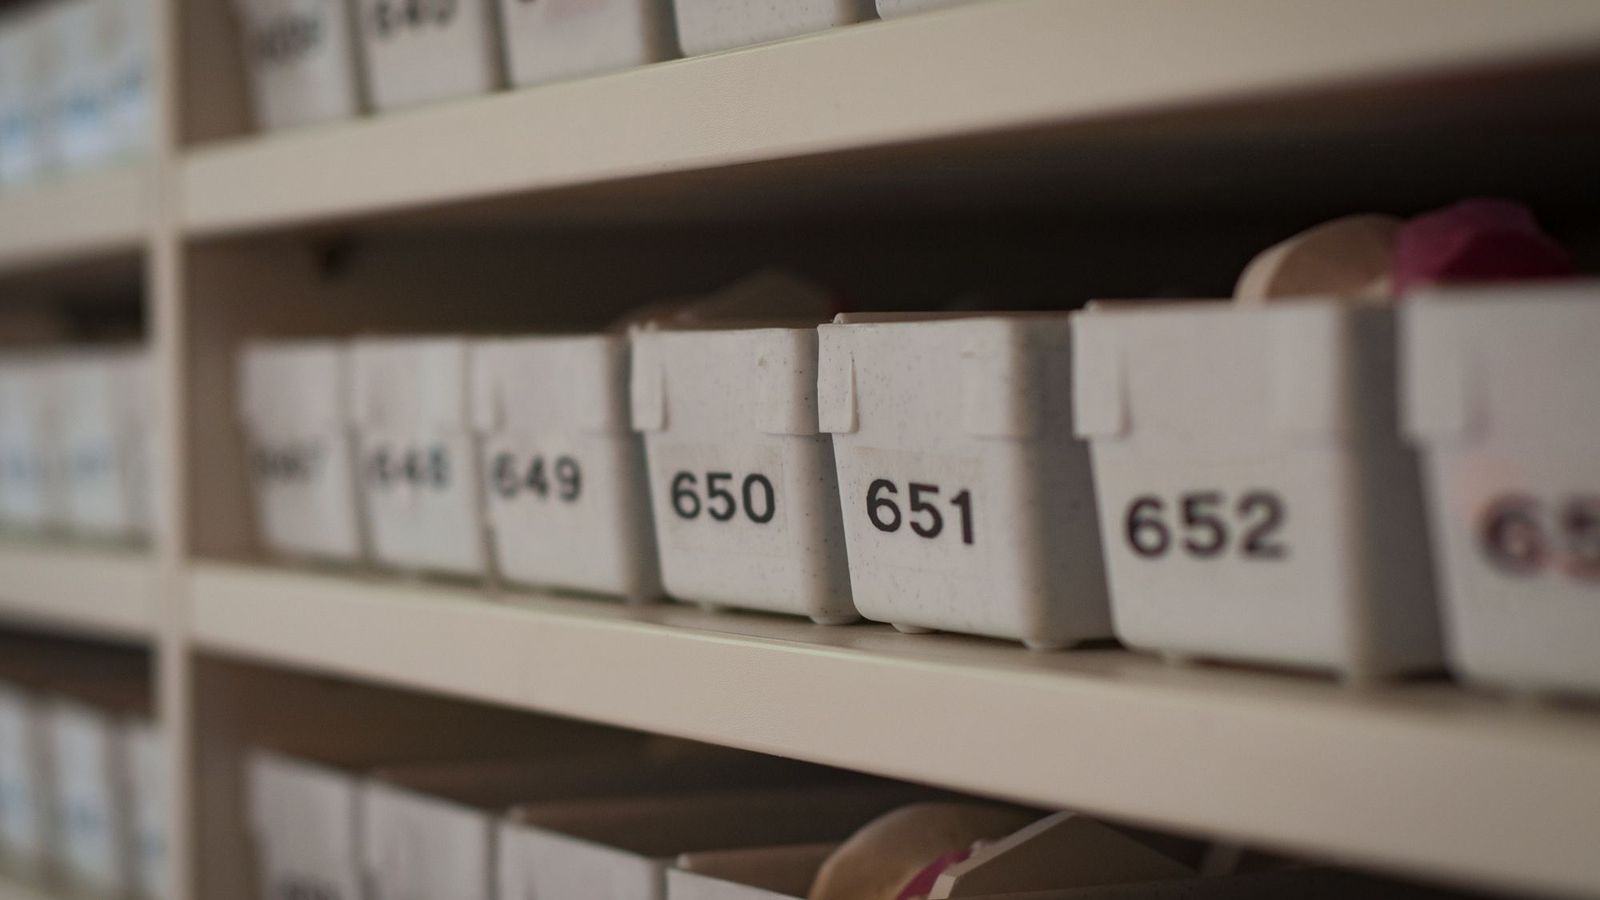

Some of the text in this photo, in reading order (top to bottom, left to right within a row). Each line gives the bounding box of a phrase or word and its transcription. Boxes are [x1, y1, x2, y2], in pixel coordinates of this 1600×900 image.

[492, 451, 582, 502] 649
[670, 471, 776, 524] 650
[866, 478, 975, 545] 651
[1124, 492, 1288, 560] 652
[1479, 492, 1600, 581] 65
